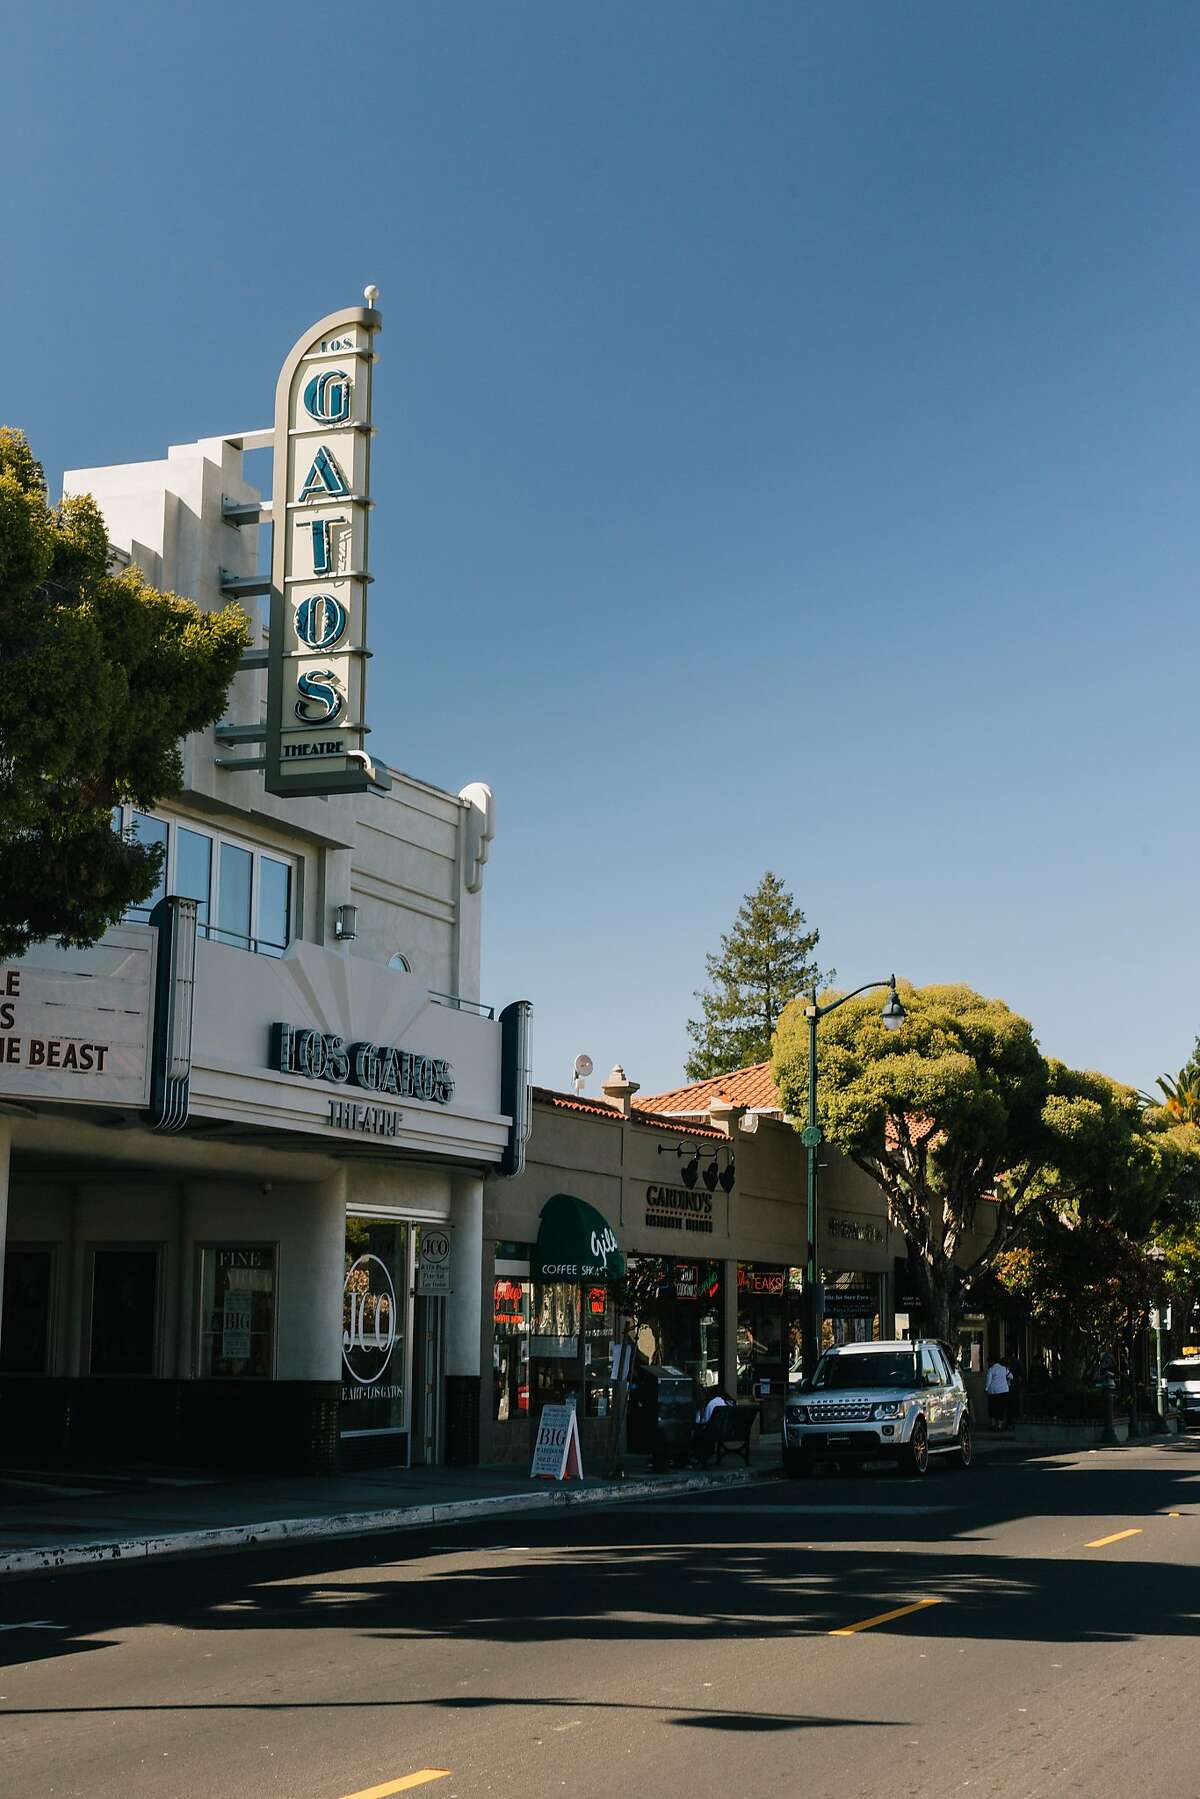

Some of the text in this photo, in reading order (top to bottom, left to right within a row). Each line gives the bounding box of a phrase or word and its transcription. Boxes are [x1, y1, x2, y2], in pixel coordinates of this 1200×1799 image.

[295, 369, 351, 725] GATOS
[283, 741, 344, 757] THEATRE
[29, 1040, 109, 1072] BEAST
[270, 1022, 455, 1105] LOS GATOS
[328, 1099, 403, 1137] THEATRE
[219, 1250, 262, 1267] FINE
[423, 1239, 447, 1255] JCO
[542, 1264, 578, 1276] COFFEE
[343, 1292, 394, 1353] JCO
[539, 1427, 567, 1446] BIG
